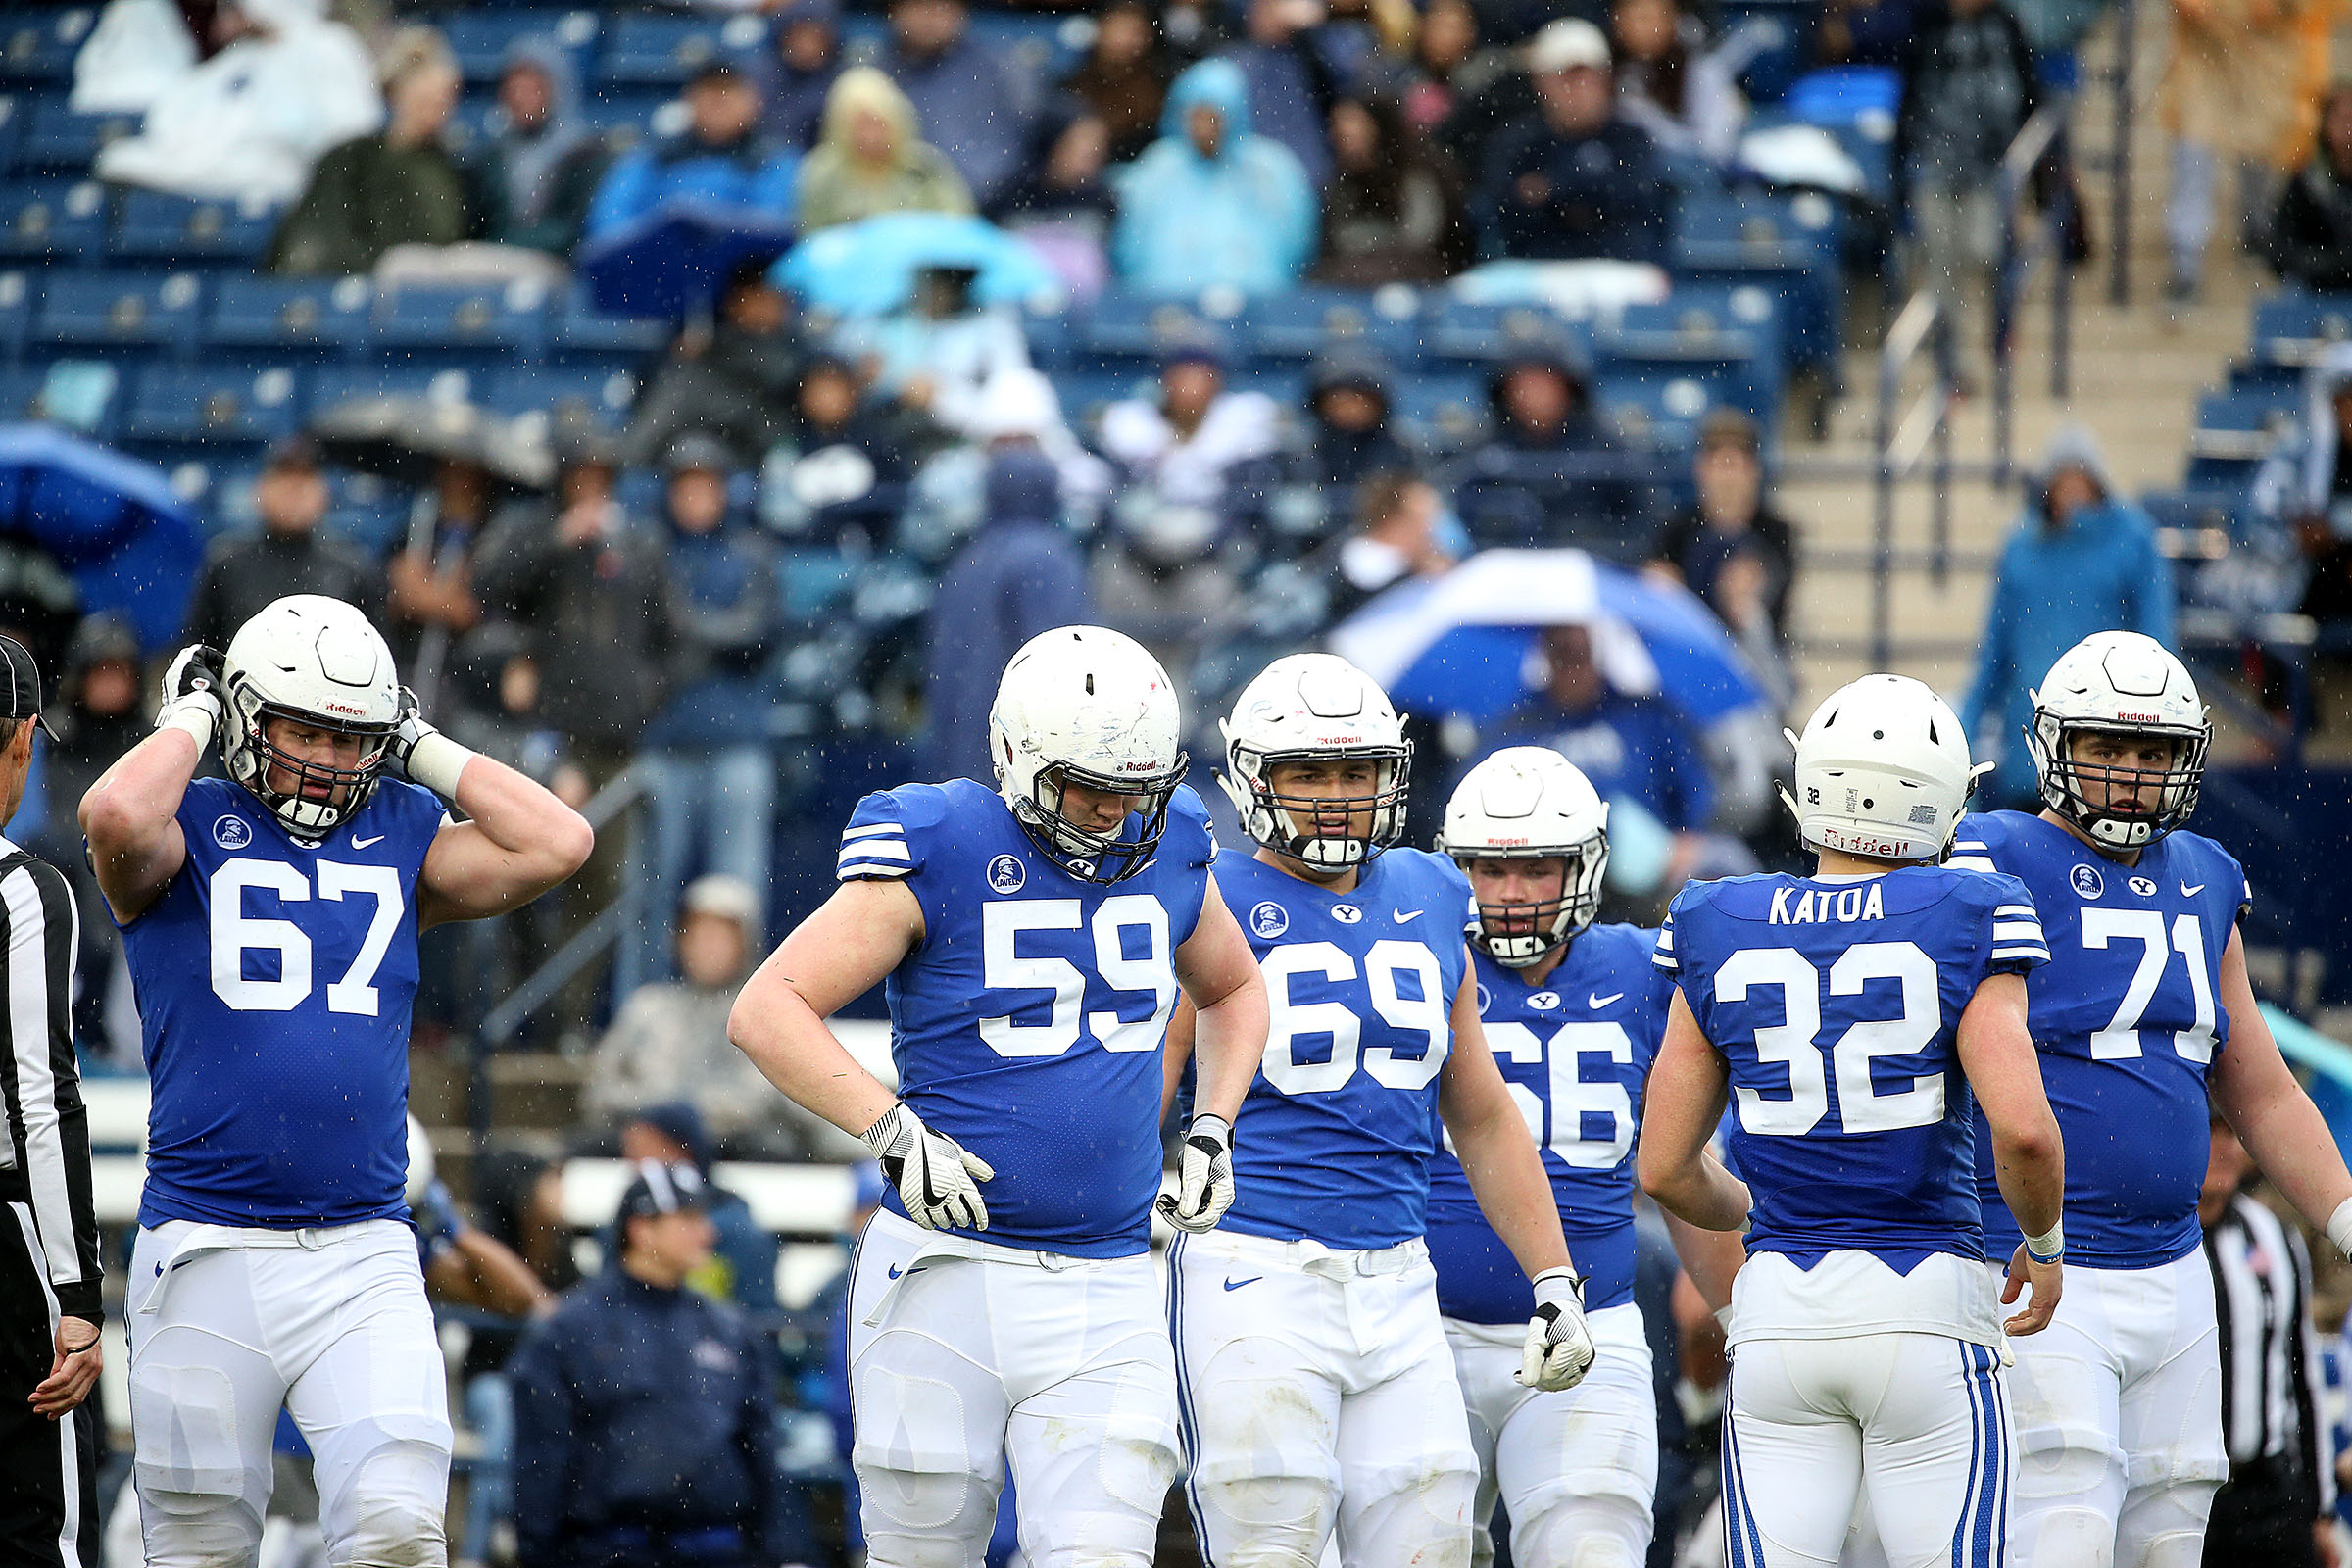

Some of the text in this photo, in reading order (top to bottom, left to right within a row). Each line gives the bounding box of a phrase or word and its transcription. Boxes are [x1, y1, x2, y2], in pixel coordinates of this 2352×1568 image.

[2117, 711, 2160, 722] Riddell
[1126, 760, 1156, 771] Riddell
[1807, 786, 1820, 805] 32
[1824, 829, 1909, 856] Riddell
[996, 878, 1021, 887] LAVELL
[2132, 880, 2151, 893] Y
[1337, 907, 1355, 920] Y
[1769, 883, 1885, 924] KATOA
[210, 858, 405, 1016] 67
[978, 894, 1177, 1058] 59
[2080, 906, 2219, 1064] 71
[1533, 995, 1553, 1006] Y
[1261, 939, 1449, 1096] 69
[1714, 941, 1945, 1136] 32
[1443, 1021, 1636, 1169] 66
